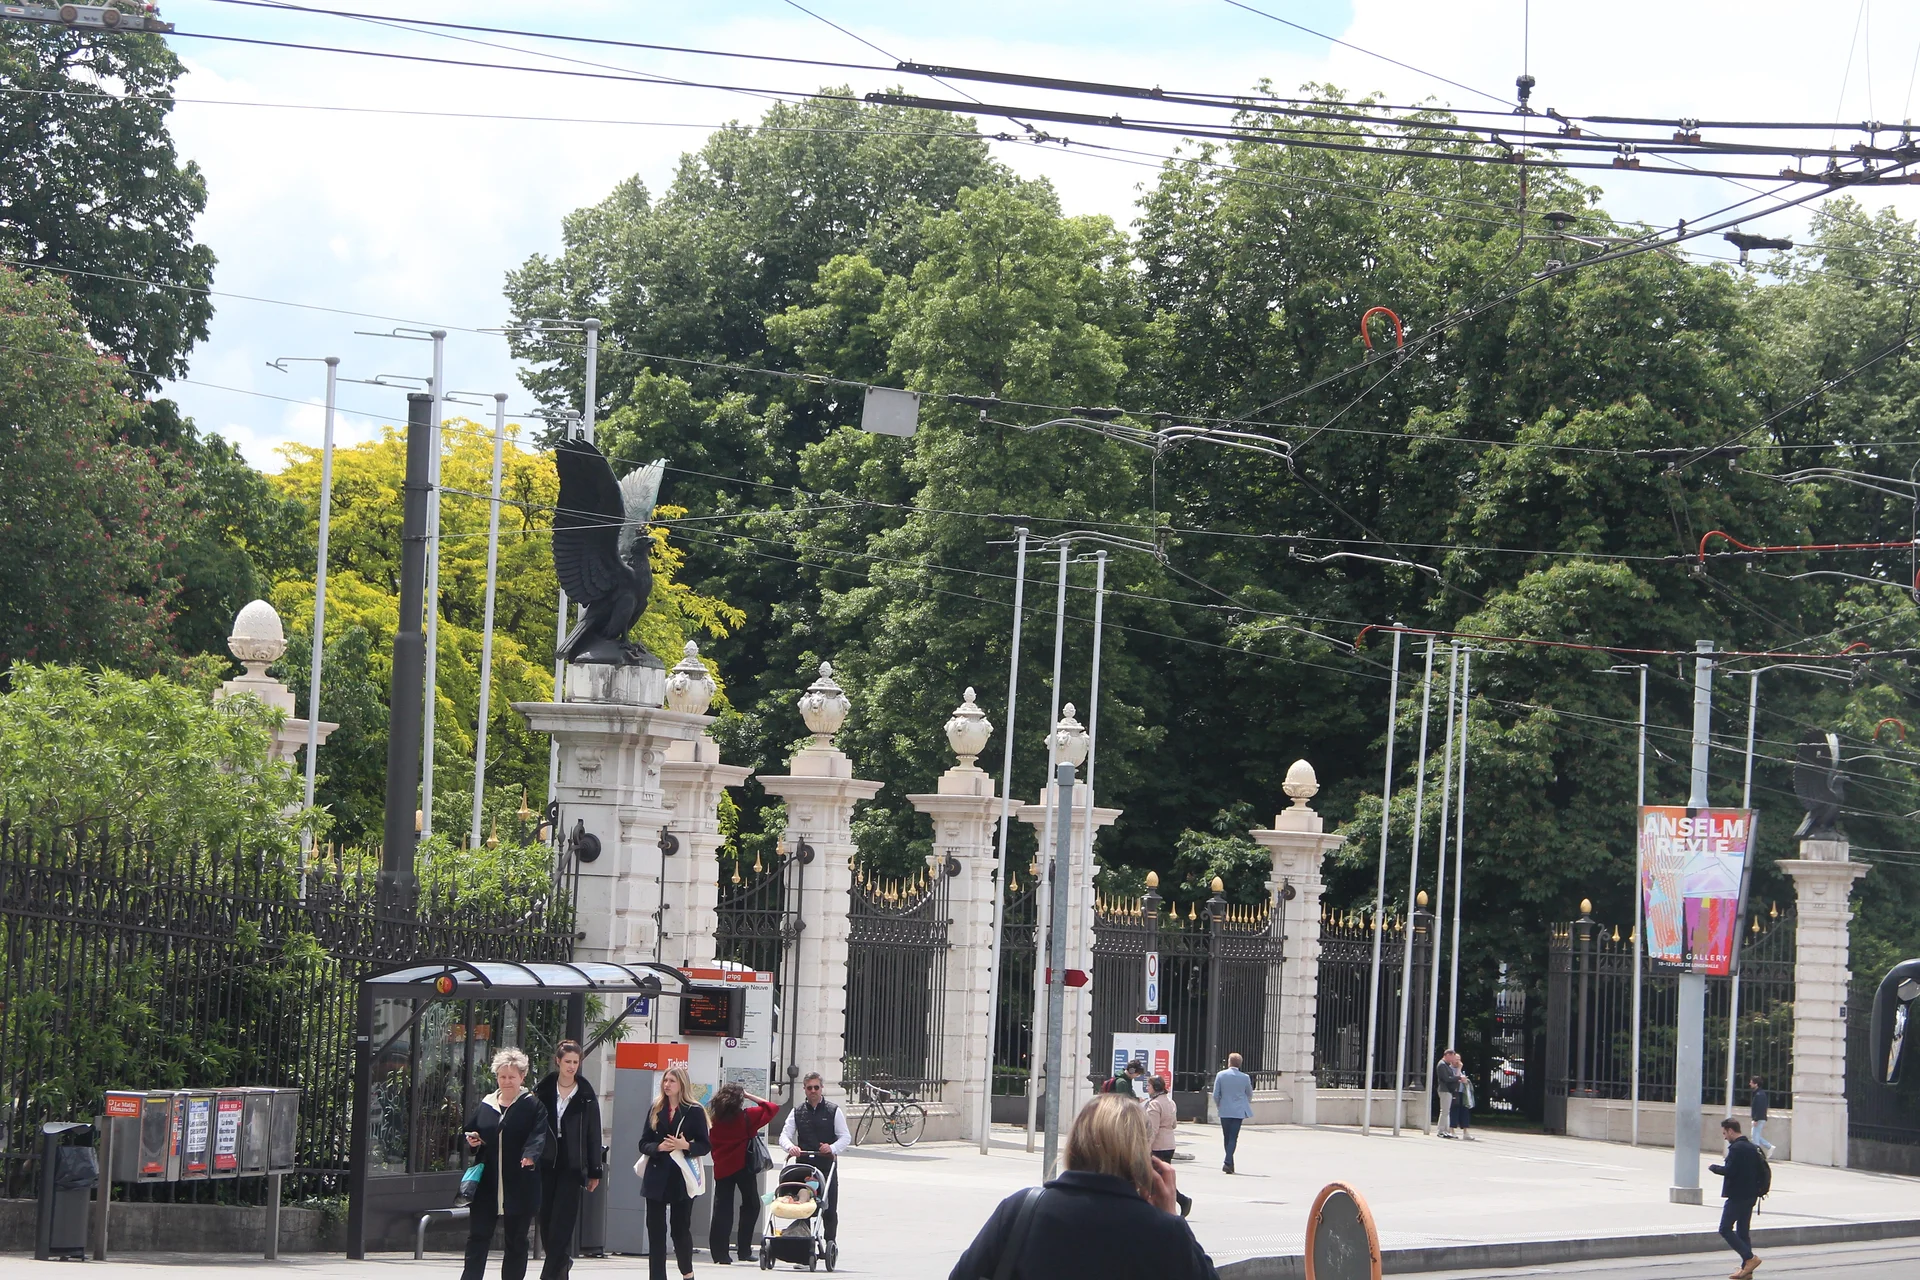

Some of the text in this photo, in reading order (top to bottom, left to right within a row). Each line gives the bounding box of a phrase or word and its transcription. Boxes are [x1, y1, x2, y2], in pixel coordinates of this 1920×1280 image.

[1644, 817, 1743, 838] ANSELM
[1655, 838, 1729, 857] REYLE
[1686, 953, 1728, 961] GALLERY
[726, 1039, 736, 1047] 18
[667, 1058, 689, 1069] Tickets
